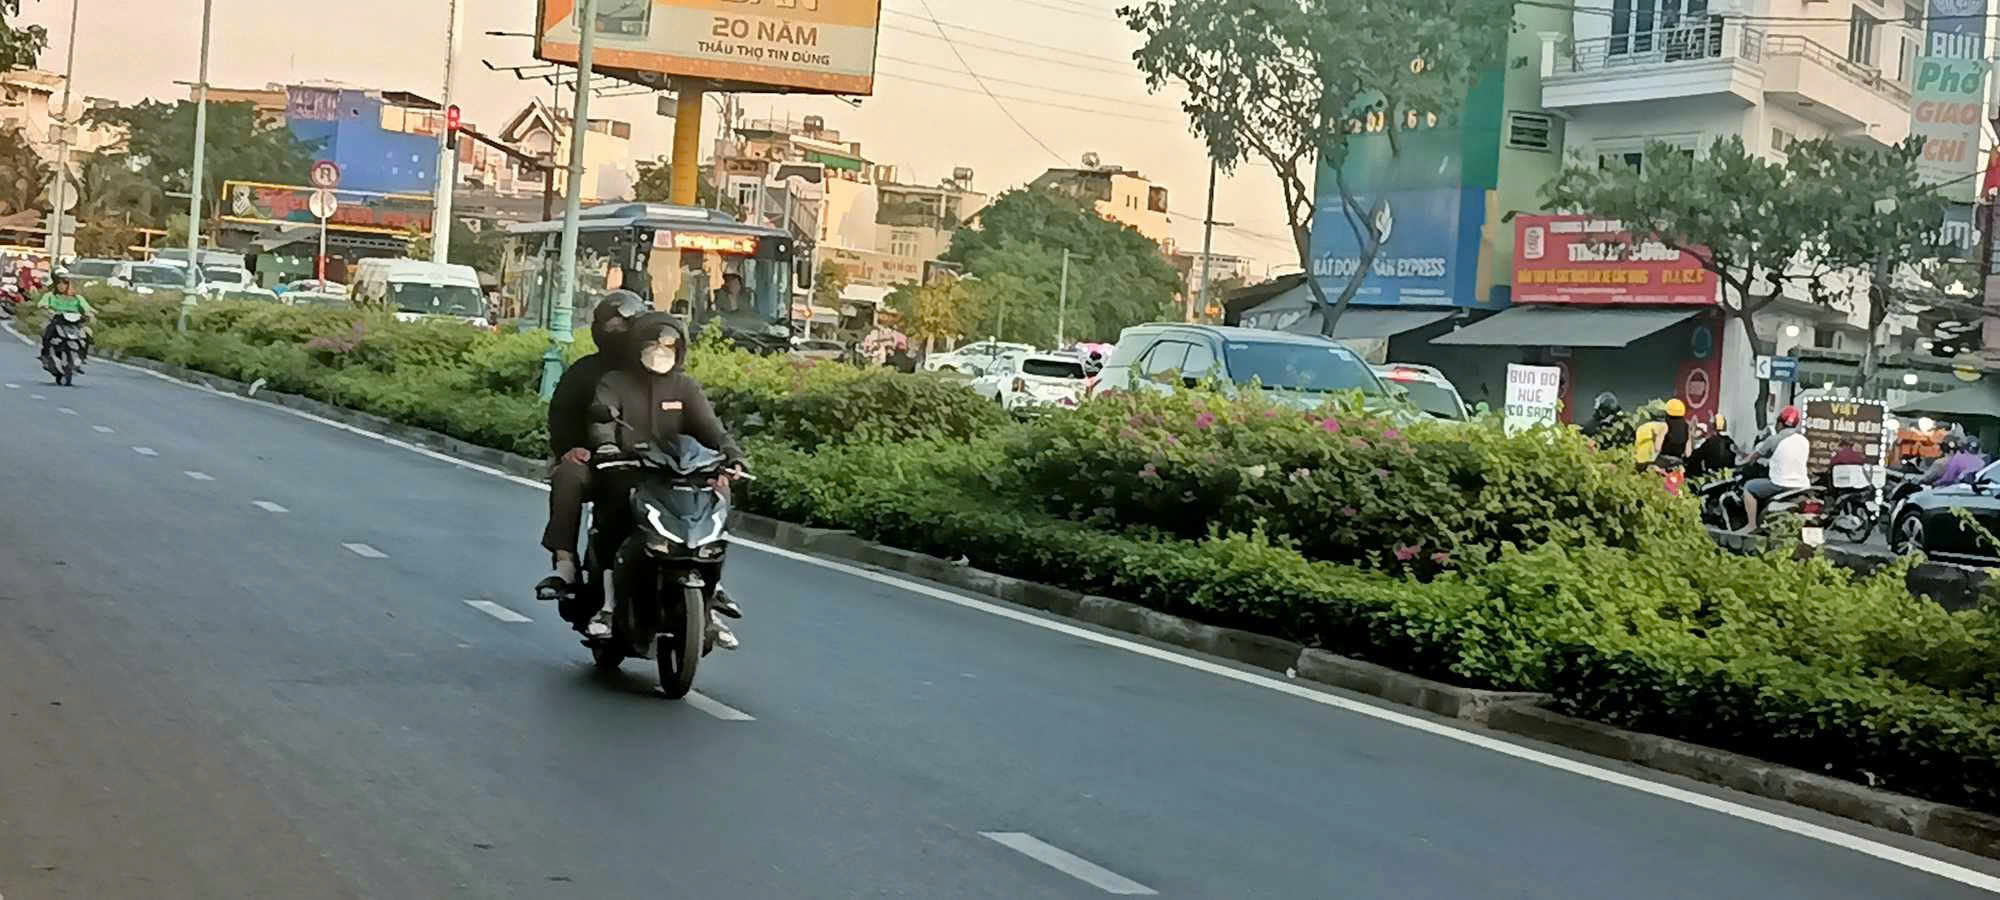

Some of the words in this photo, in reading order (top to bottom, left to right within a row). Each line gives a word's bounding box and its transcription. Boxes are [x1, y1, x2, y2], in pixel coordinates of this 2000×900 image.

[712, 17, 749, 38] 20
[757, 20, 818, 46] NĂM
[767, 48, 789, 61] TIN
[1915, 100, 1981, 125] GIAO
[1397, 256, 1447, 277] EXPRESS
